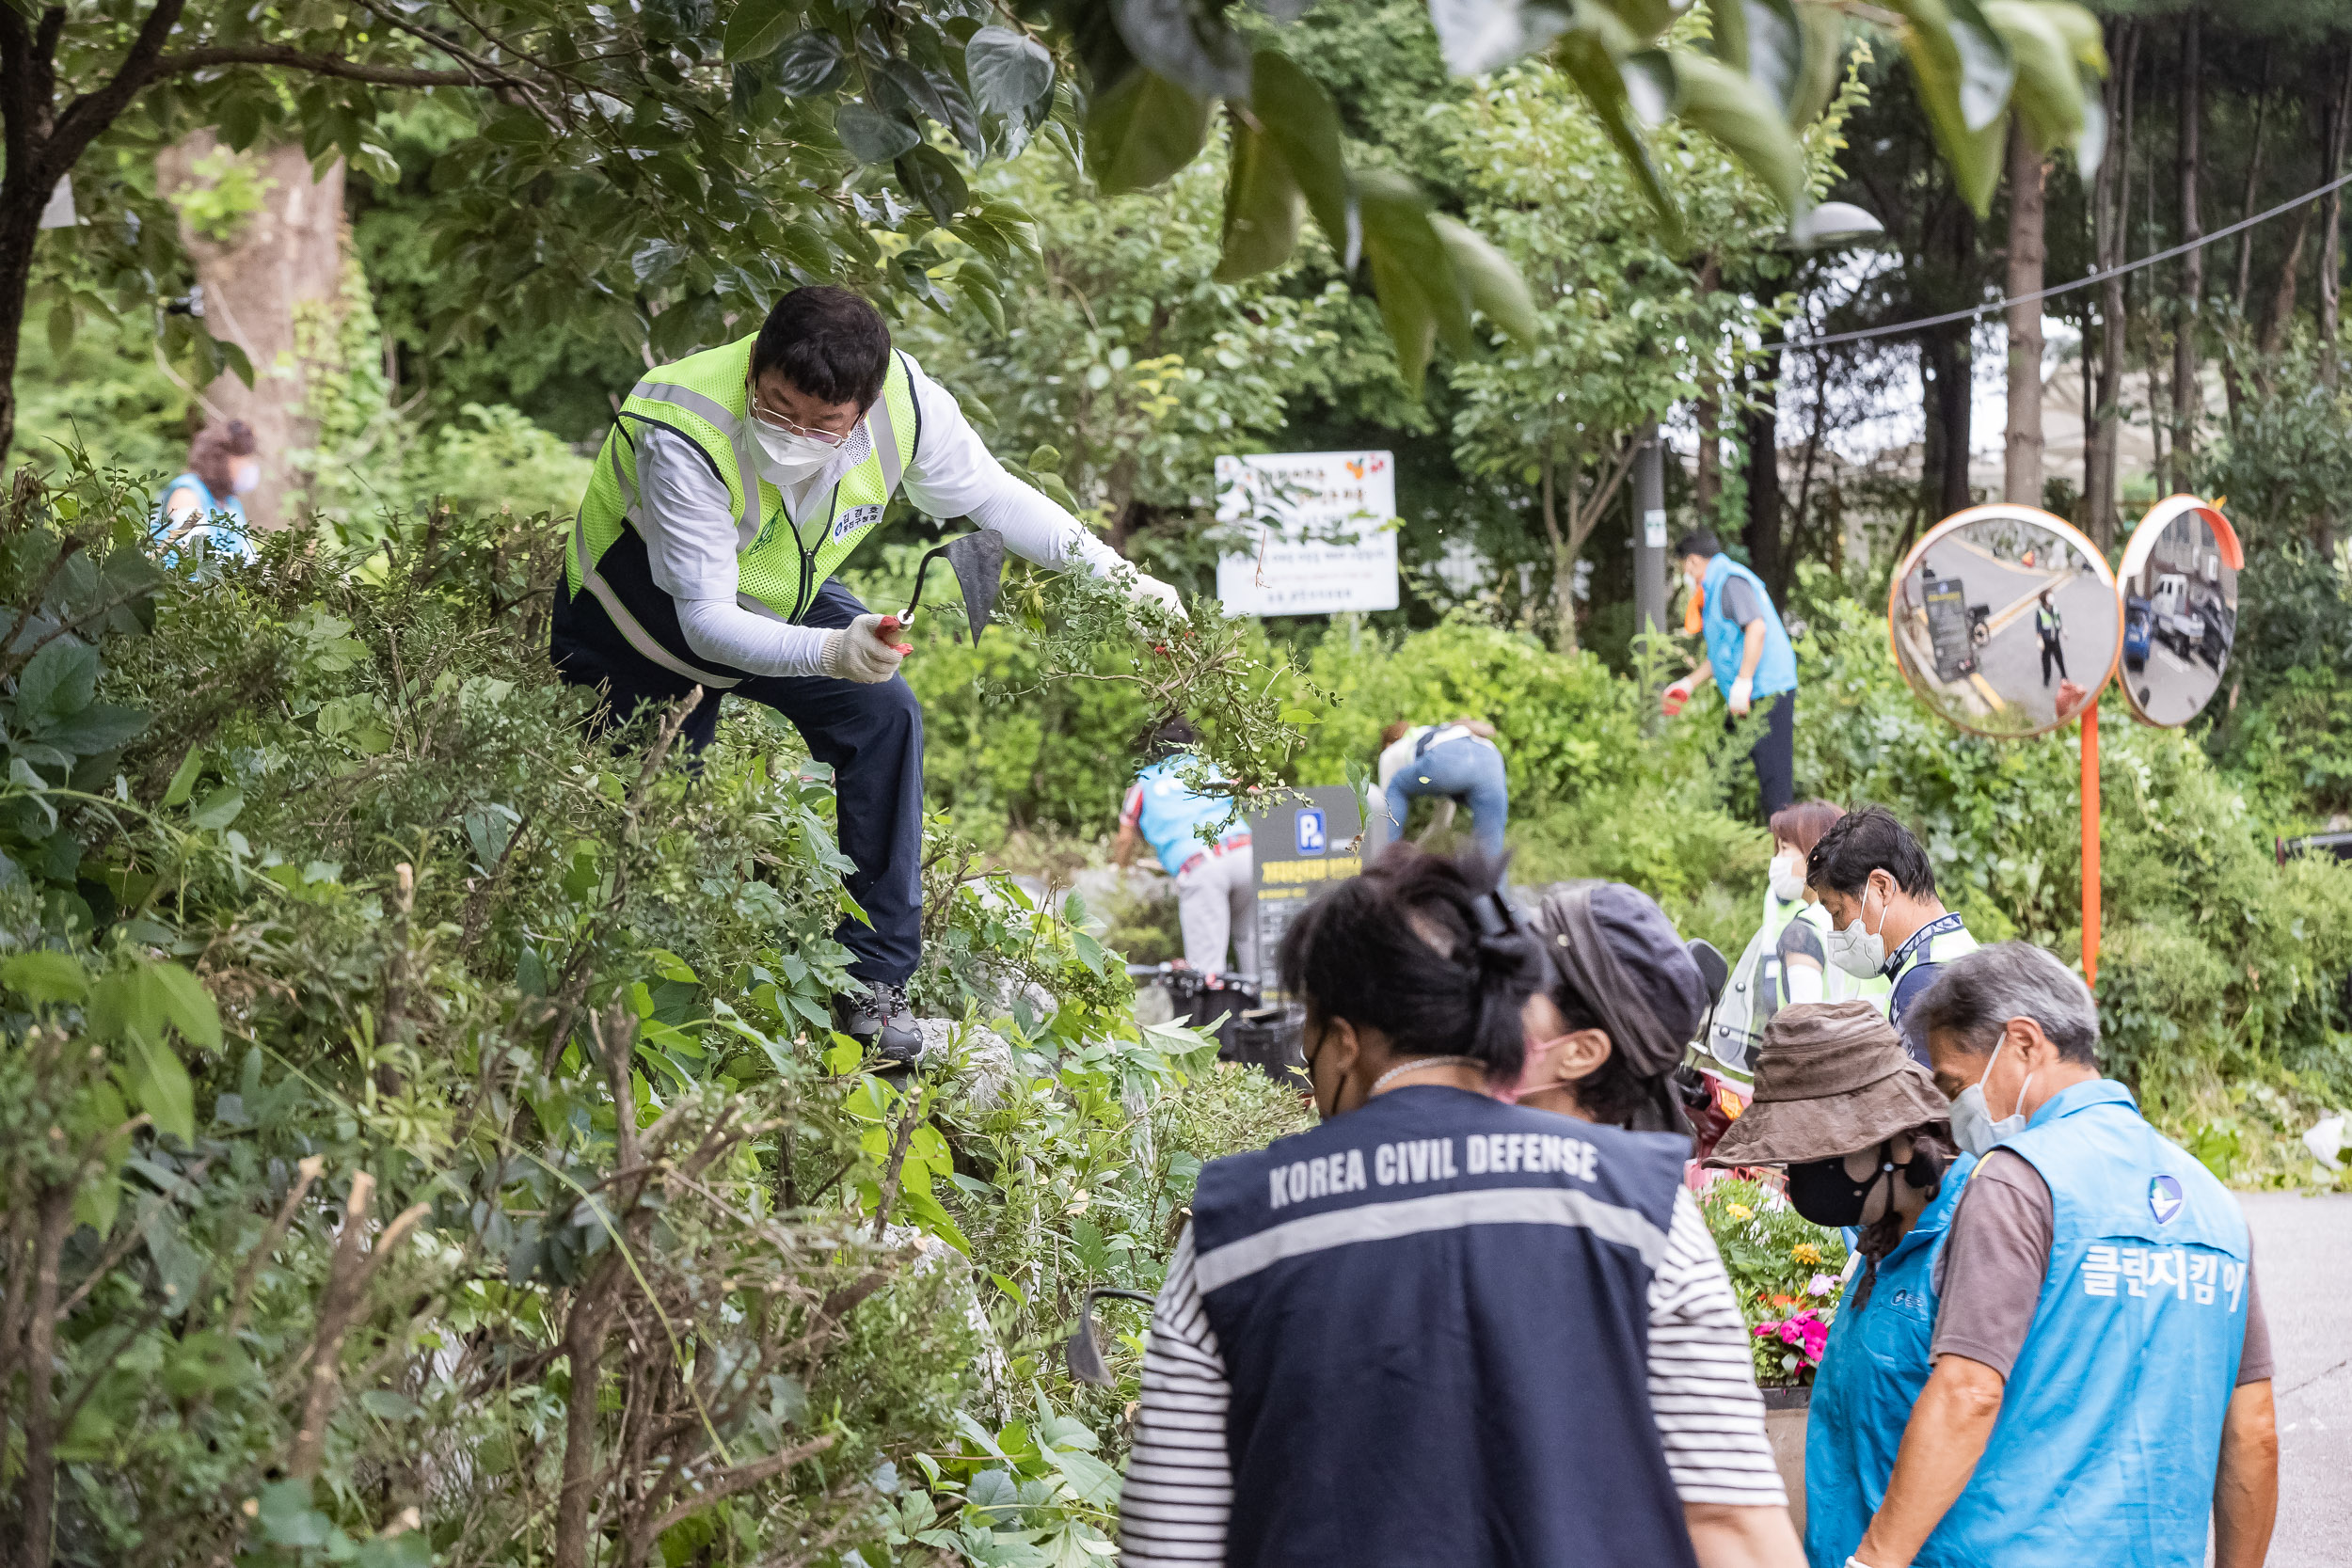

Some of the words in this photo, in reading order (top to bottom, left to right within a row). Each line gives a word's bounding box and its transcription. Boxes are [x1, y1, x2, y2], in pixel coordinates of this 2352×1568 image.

[1270, 1149, 1367, 1210] KOREA
[1375, 1137, 1458, 1186] CIVIL
[1466, 1133, 1598, 1183] DEFENSE
[2080, 1244, 2247, 1313] 클린지킴이
